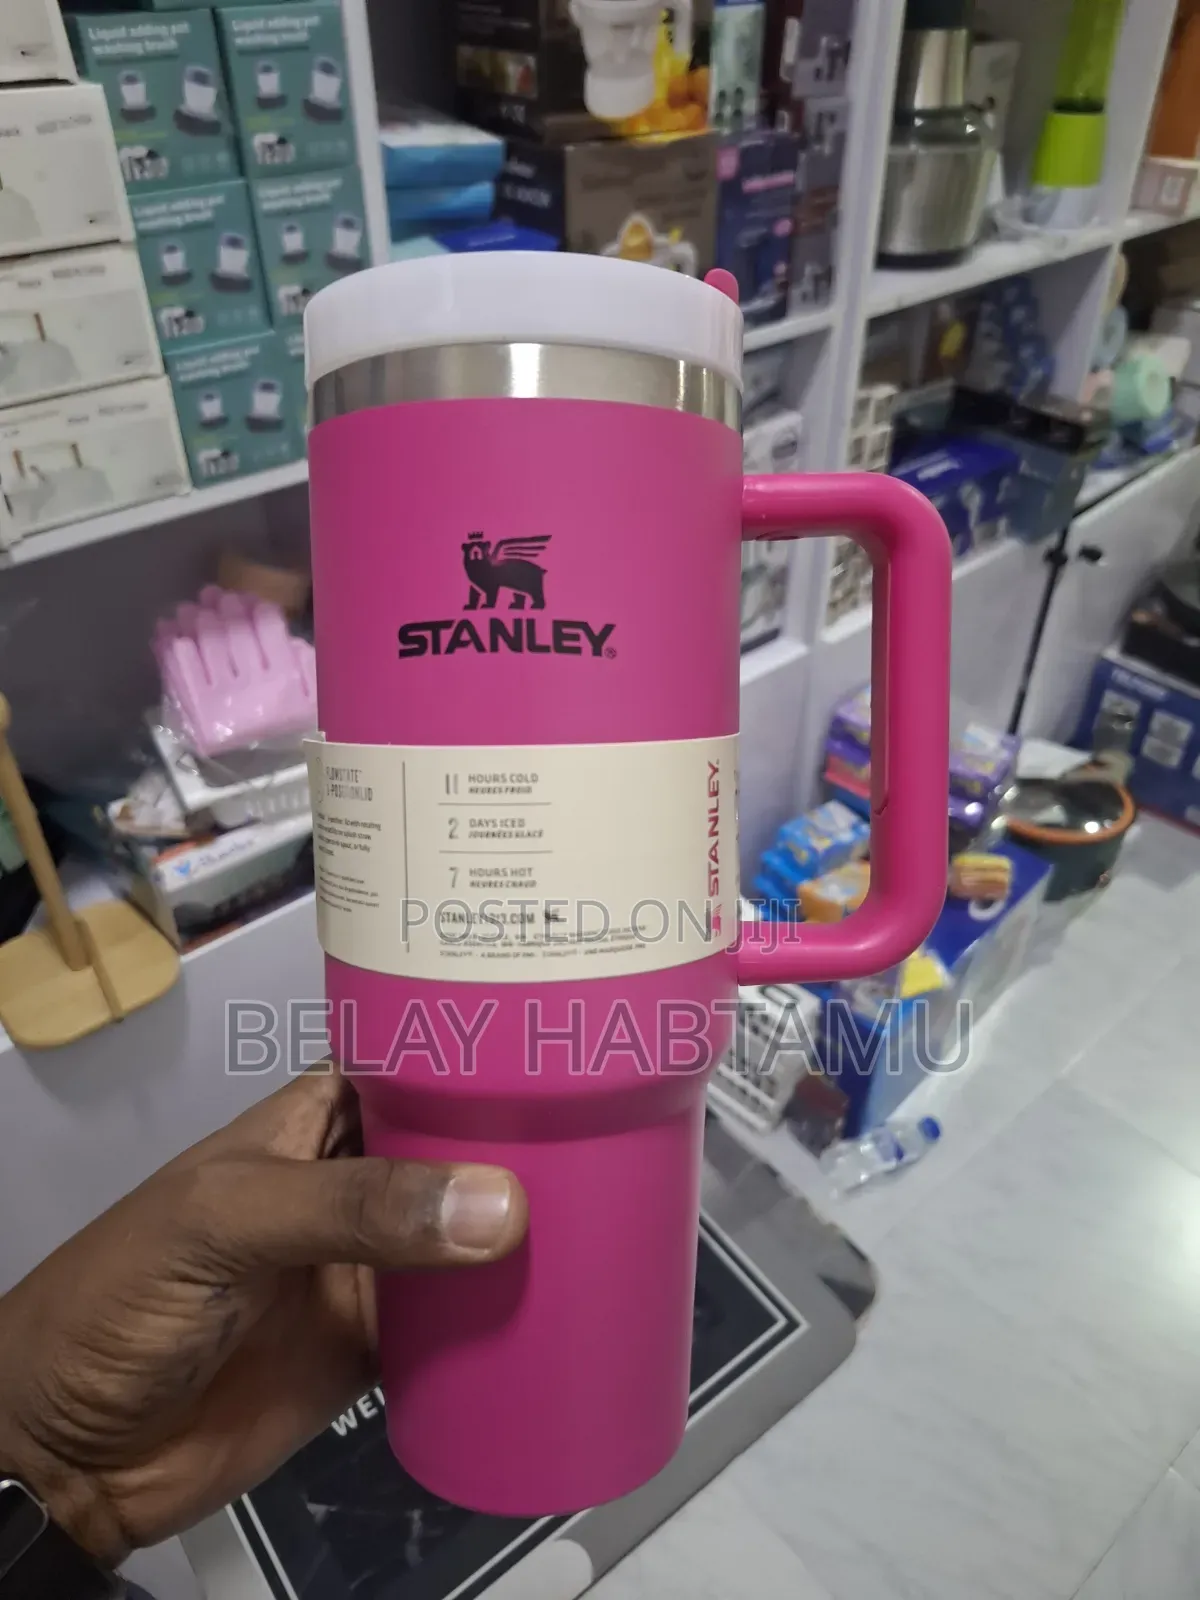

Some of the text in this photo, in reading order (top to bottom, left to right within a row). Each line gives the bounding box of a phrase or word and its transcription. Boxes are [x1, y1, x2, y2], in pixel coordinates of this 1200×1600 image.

[468, 773, 539, 784] HOURS COLD
[447, 817, 460, 840] 2
[468, 818, 526, 828] DAYS ICED
[447, 866, 459, 888] 7
[468, 867, 534, 878] HOURS HOT
